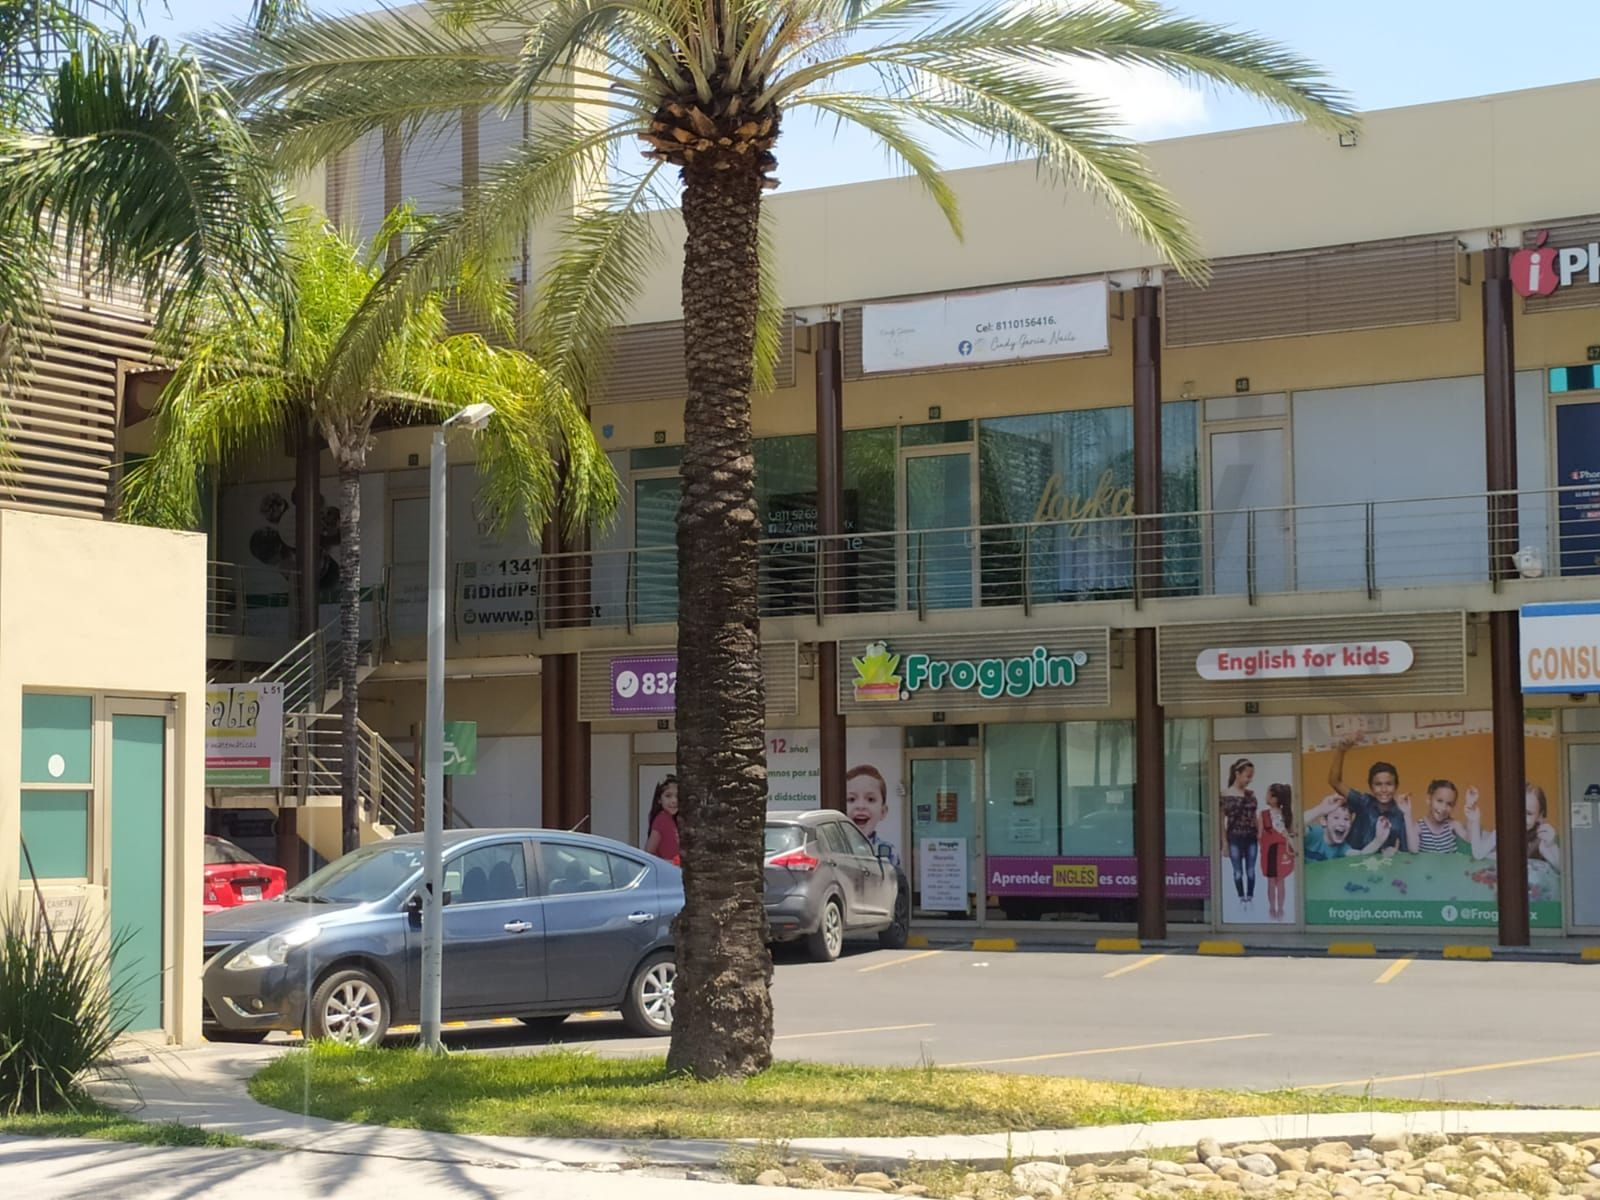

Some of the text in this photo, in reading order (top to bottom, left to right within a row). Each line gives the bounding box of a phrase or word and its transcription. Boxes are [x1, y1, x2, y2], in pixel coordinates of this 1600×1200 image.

[975, 323, 994, 334] Cel:
[1217, 646, 1390, 676] English for kids
[907, 646, 1075, 698] Froggin
[770, 738, 787, 753] 12
[791, 770, 807, 778] por
[992, 871, 1052, 887] Aprender
[1055, 867, 1095, 885] INGLÉS
[1099, 874, 1114, 885] es
[1165, 871, 1202, 886] niños
[1328, 907, 1423, 921] froggin.com.mx
